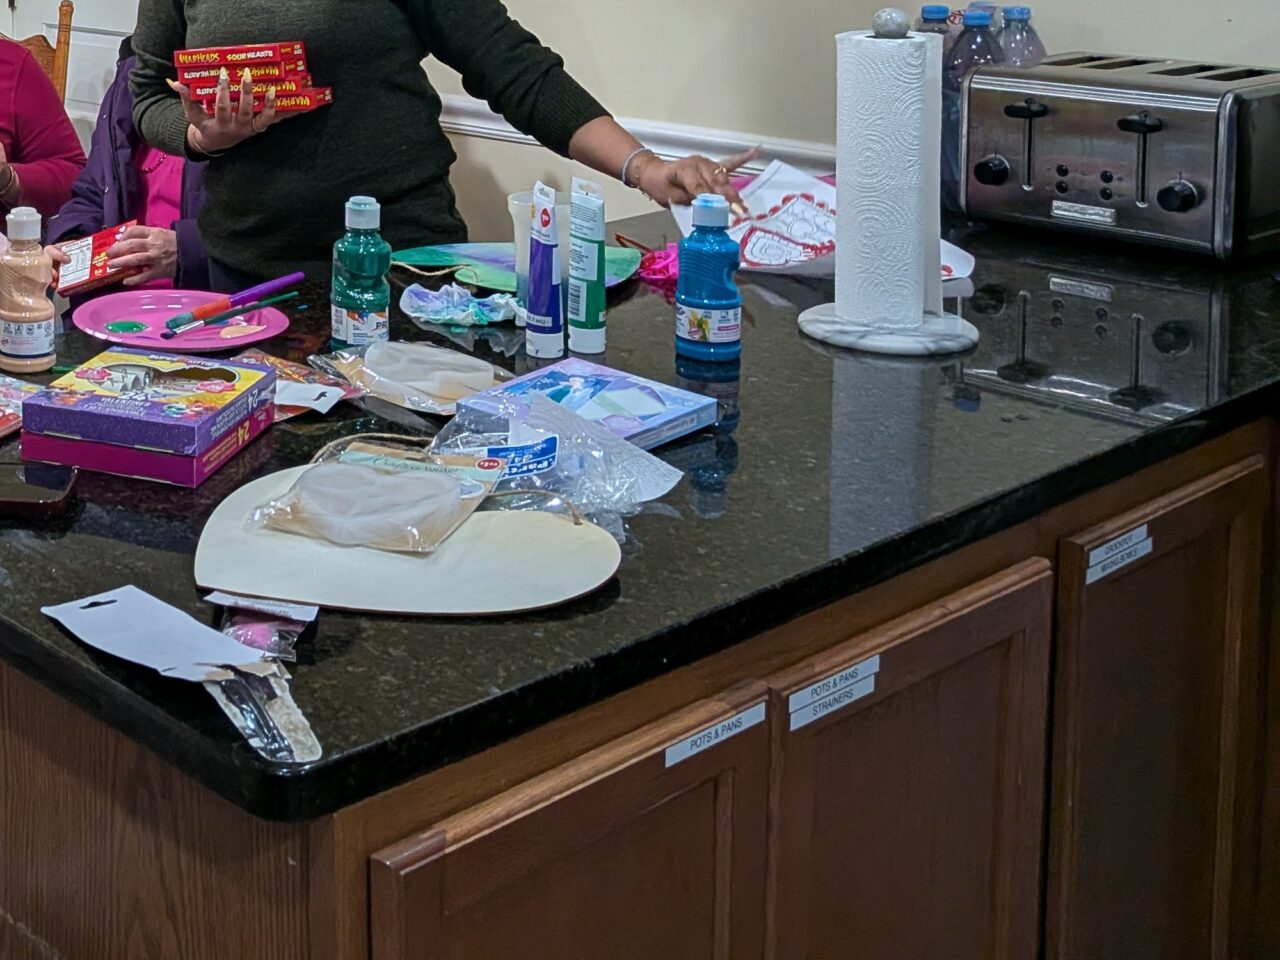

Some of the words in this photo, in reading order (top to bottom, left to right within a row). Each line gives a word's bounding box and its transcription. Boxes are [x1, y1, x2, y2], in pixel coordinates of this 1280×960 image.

[179, 52, 220, 64] WARHEADS
[227, 52, 247, 61] SOUR
[247, 388, 259, 412] 24
[237, 419, 251, 447] 24
[811, 681, 832, 699] POTS
[832, 677, 839, 688] &
[839, 667, 860, 686] PANS
[812, 689, 854, 717] STRAINERS
[689, 730, 713, 751] POTS
[713, 728, 721, 740] &
[721, 717, 743, 738] PANS
